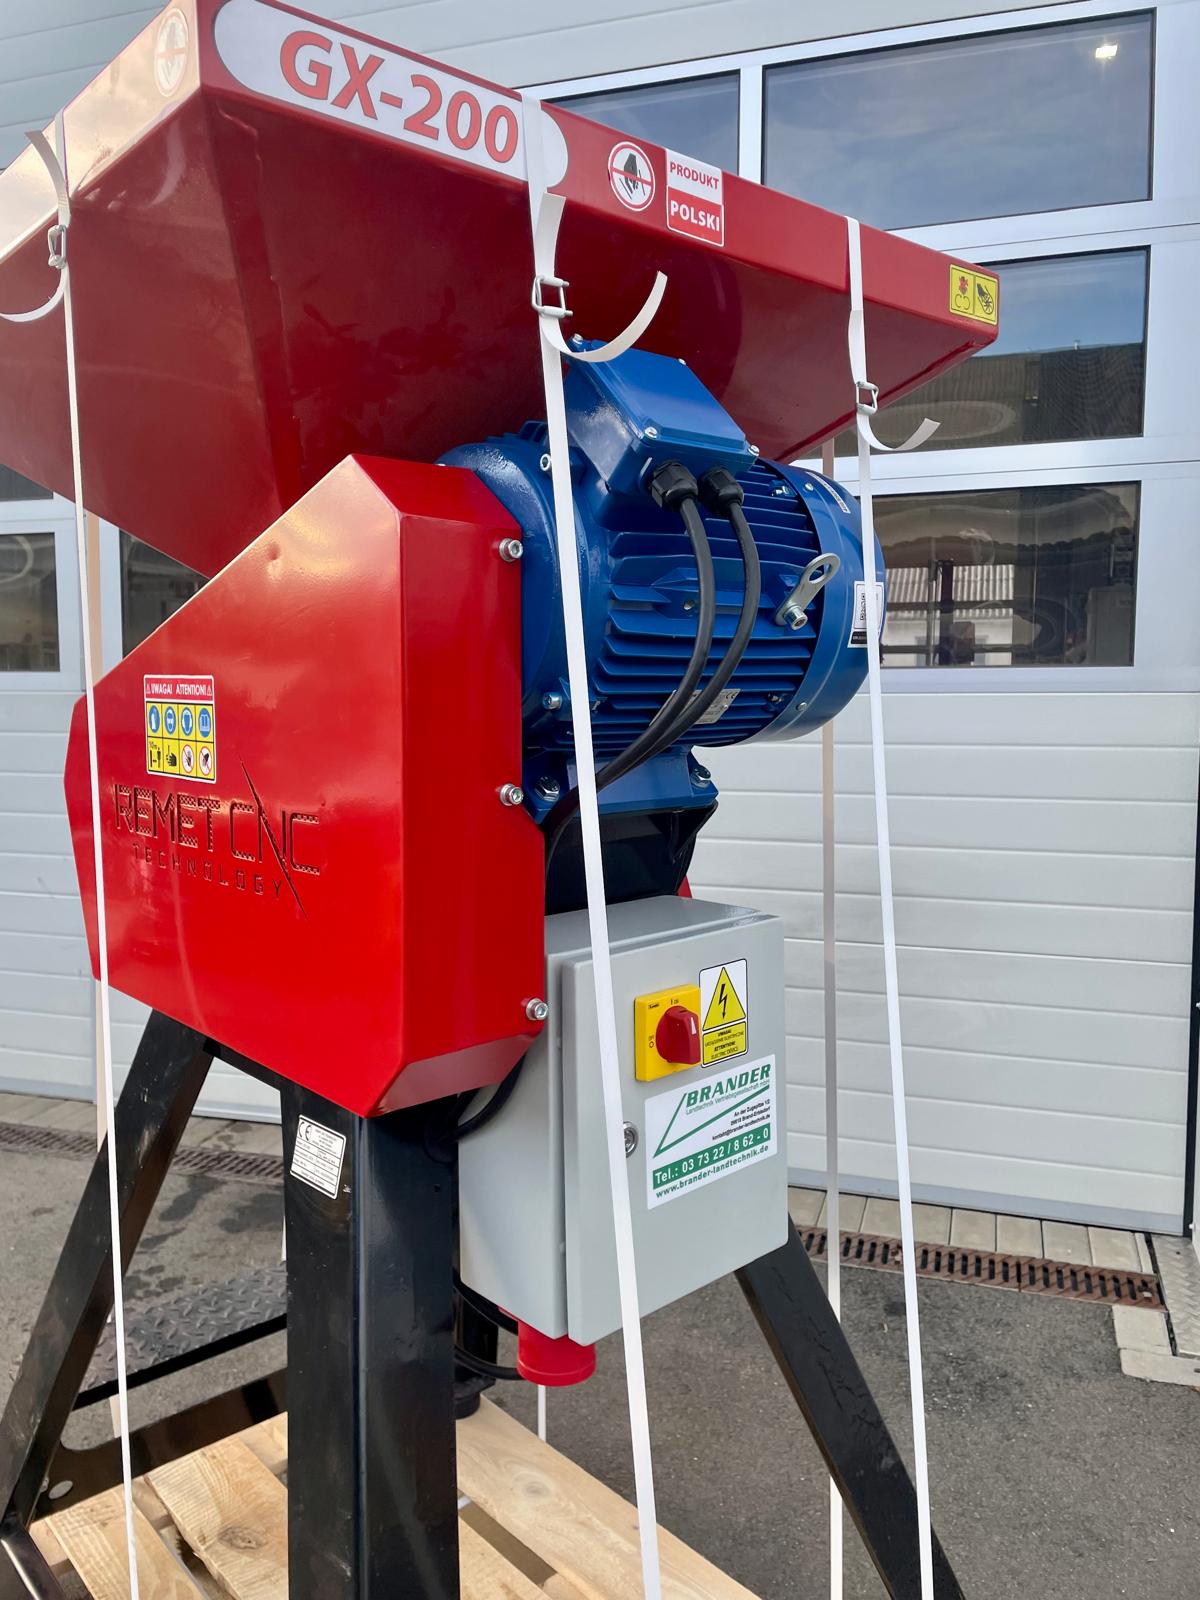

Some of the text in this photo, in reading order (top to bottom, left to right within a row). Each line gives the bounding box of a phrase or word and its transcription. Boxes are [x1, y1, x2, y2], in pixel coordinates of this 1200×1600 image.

[279, 30, 519, 164] GX-200
[669, 161, 720, 190] PRODUKT
[670, 200, 720, 231] POLSKI
[115, 784, 221, 852] REMET
[132, 842, 283, 899] TECHNOLOGY
[686, 1064, 771, 1107] BRANDER
[655, 1168, 678, 1184] Tel.:
[682, 1160, 694, 1173] 03
[698, 1154, 710, 1166] 73
[713, 1147, 725, 1160] 22
[733, 1140, 739, 1151] 8
[742, 1134, 754, 1147] 62
[763, 1128, 769, 1139] 0
[655, 1145, 769, 1198] www.brander-landtechnik.de
